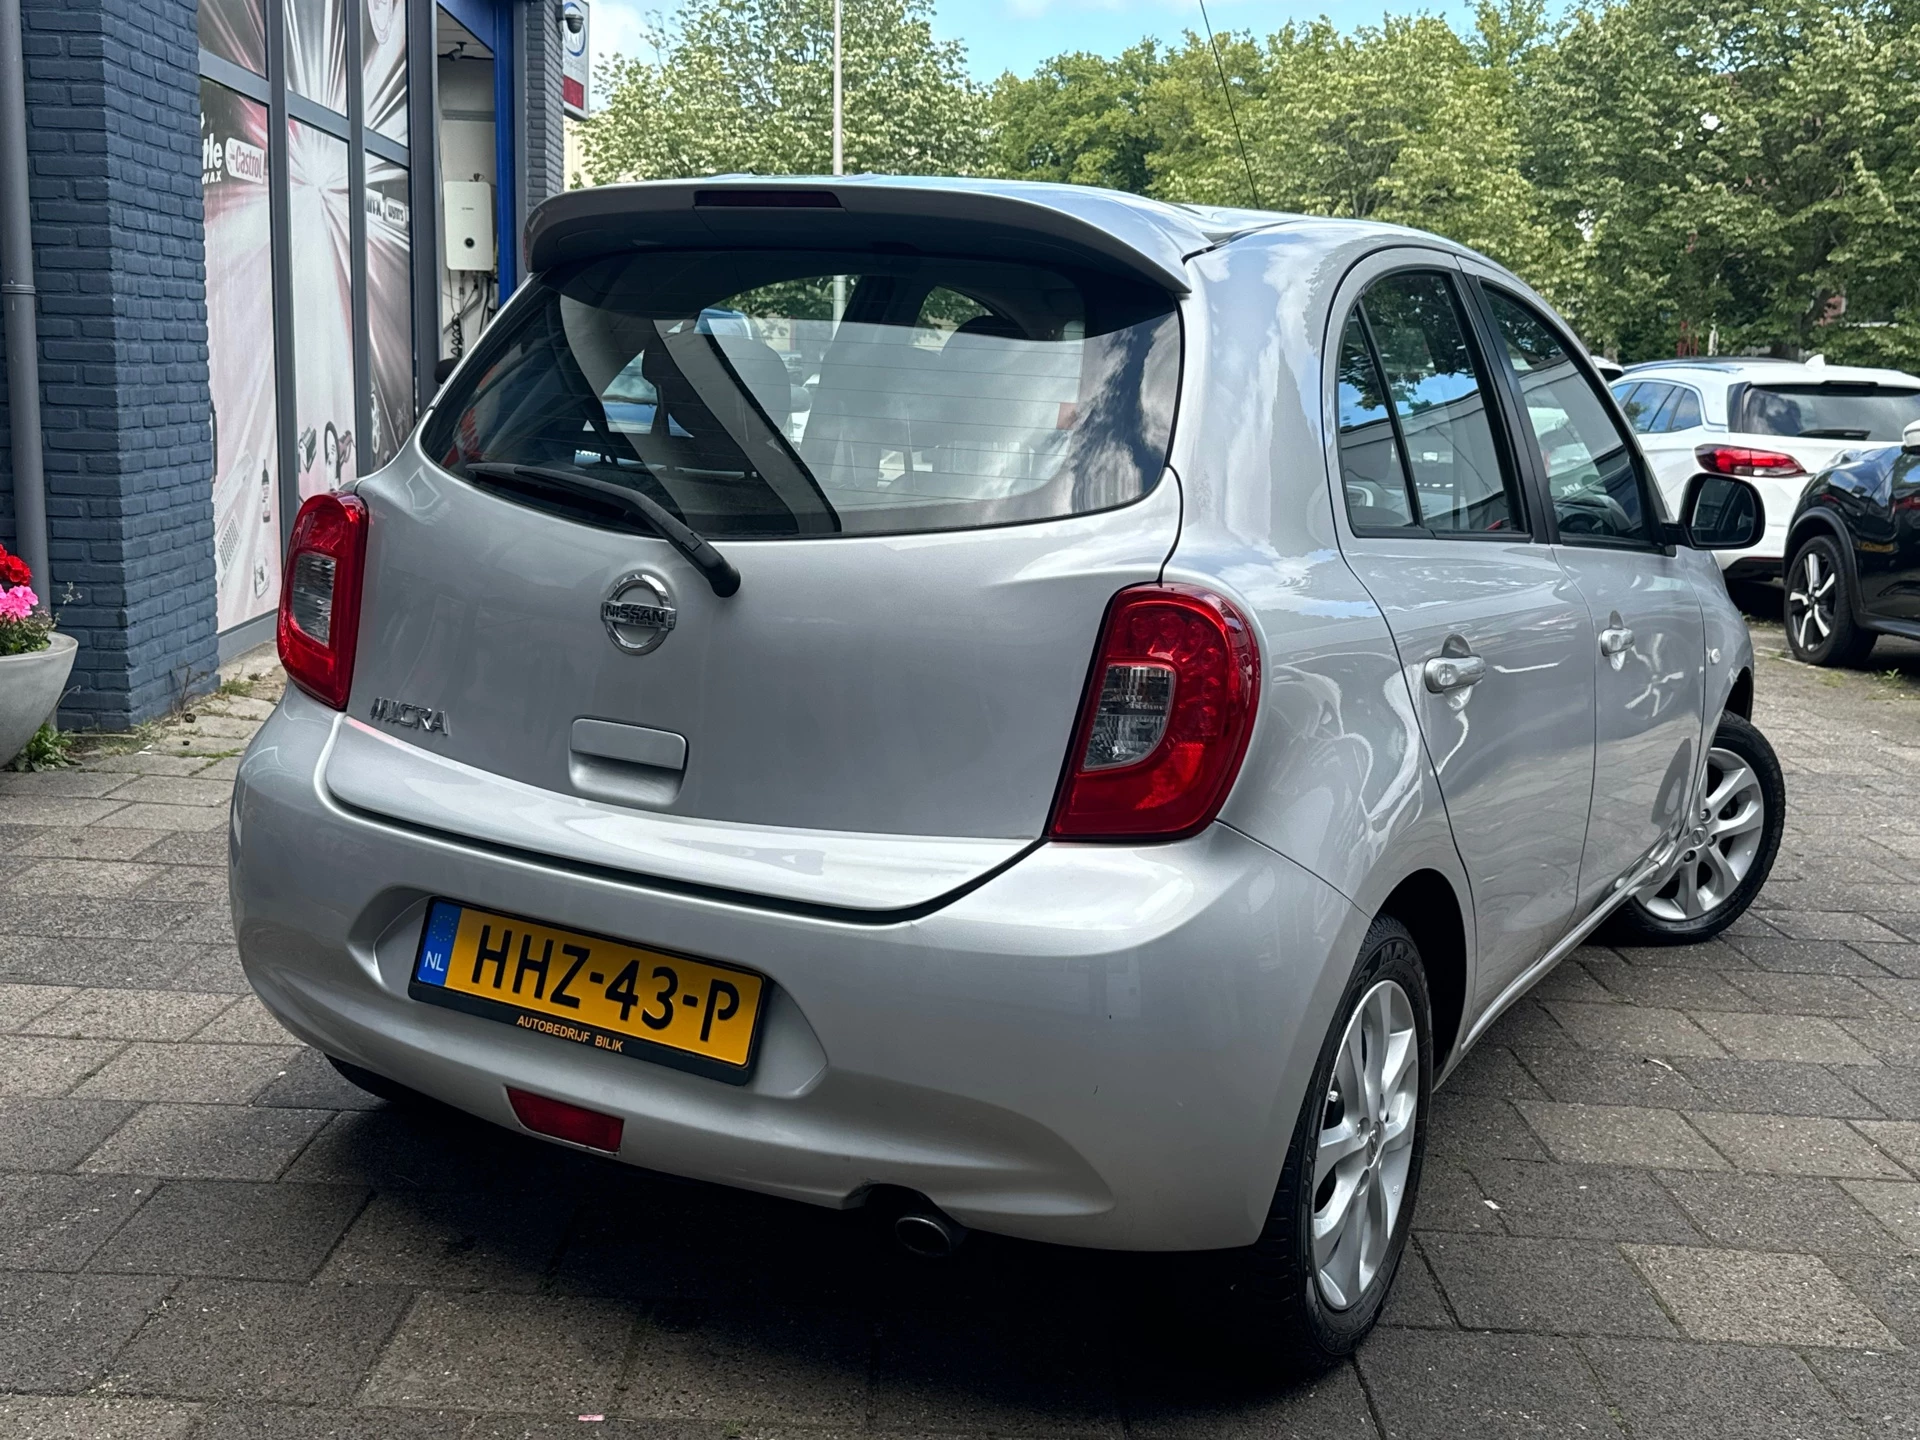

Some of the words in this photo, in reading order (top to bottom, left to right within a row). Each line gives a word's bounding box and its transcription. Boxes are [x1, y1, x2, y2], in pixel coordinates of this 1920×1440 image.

[235, 145, 262, 179] Castrol
[605, 604, 665, 623] NISSAN
[370, 697, 450, 735] MICRA
[424, 951, 444, 971] NL
[472, 925, 740, 1042] HHZ-43-P
[516, 1015, 590, 1044] AUTOBEDRIJF
[595, 1035, 623, 1053] BILIK
